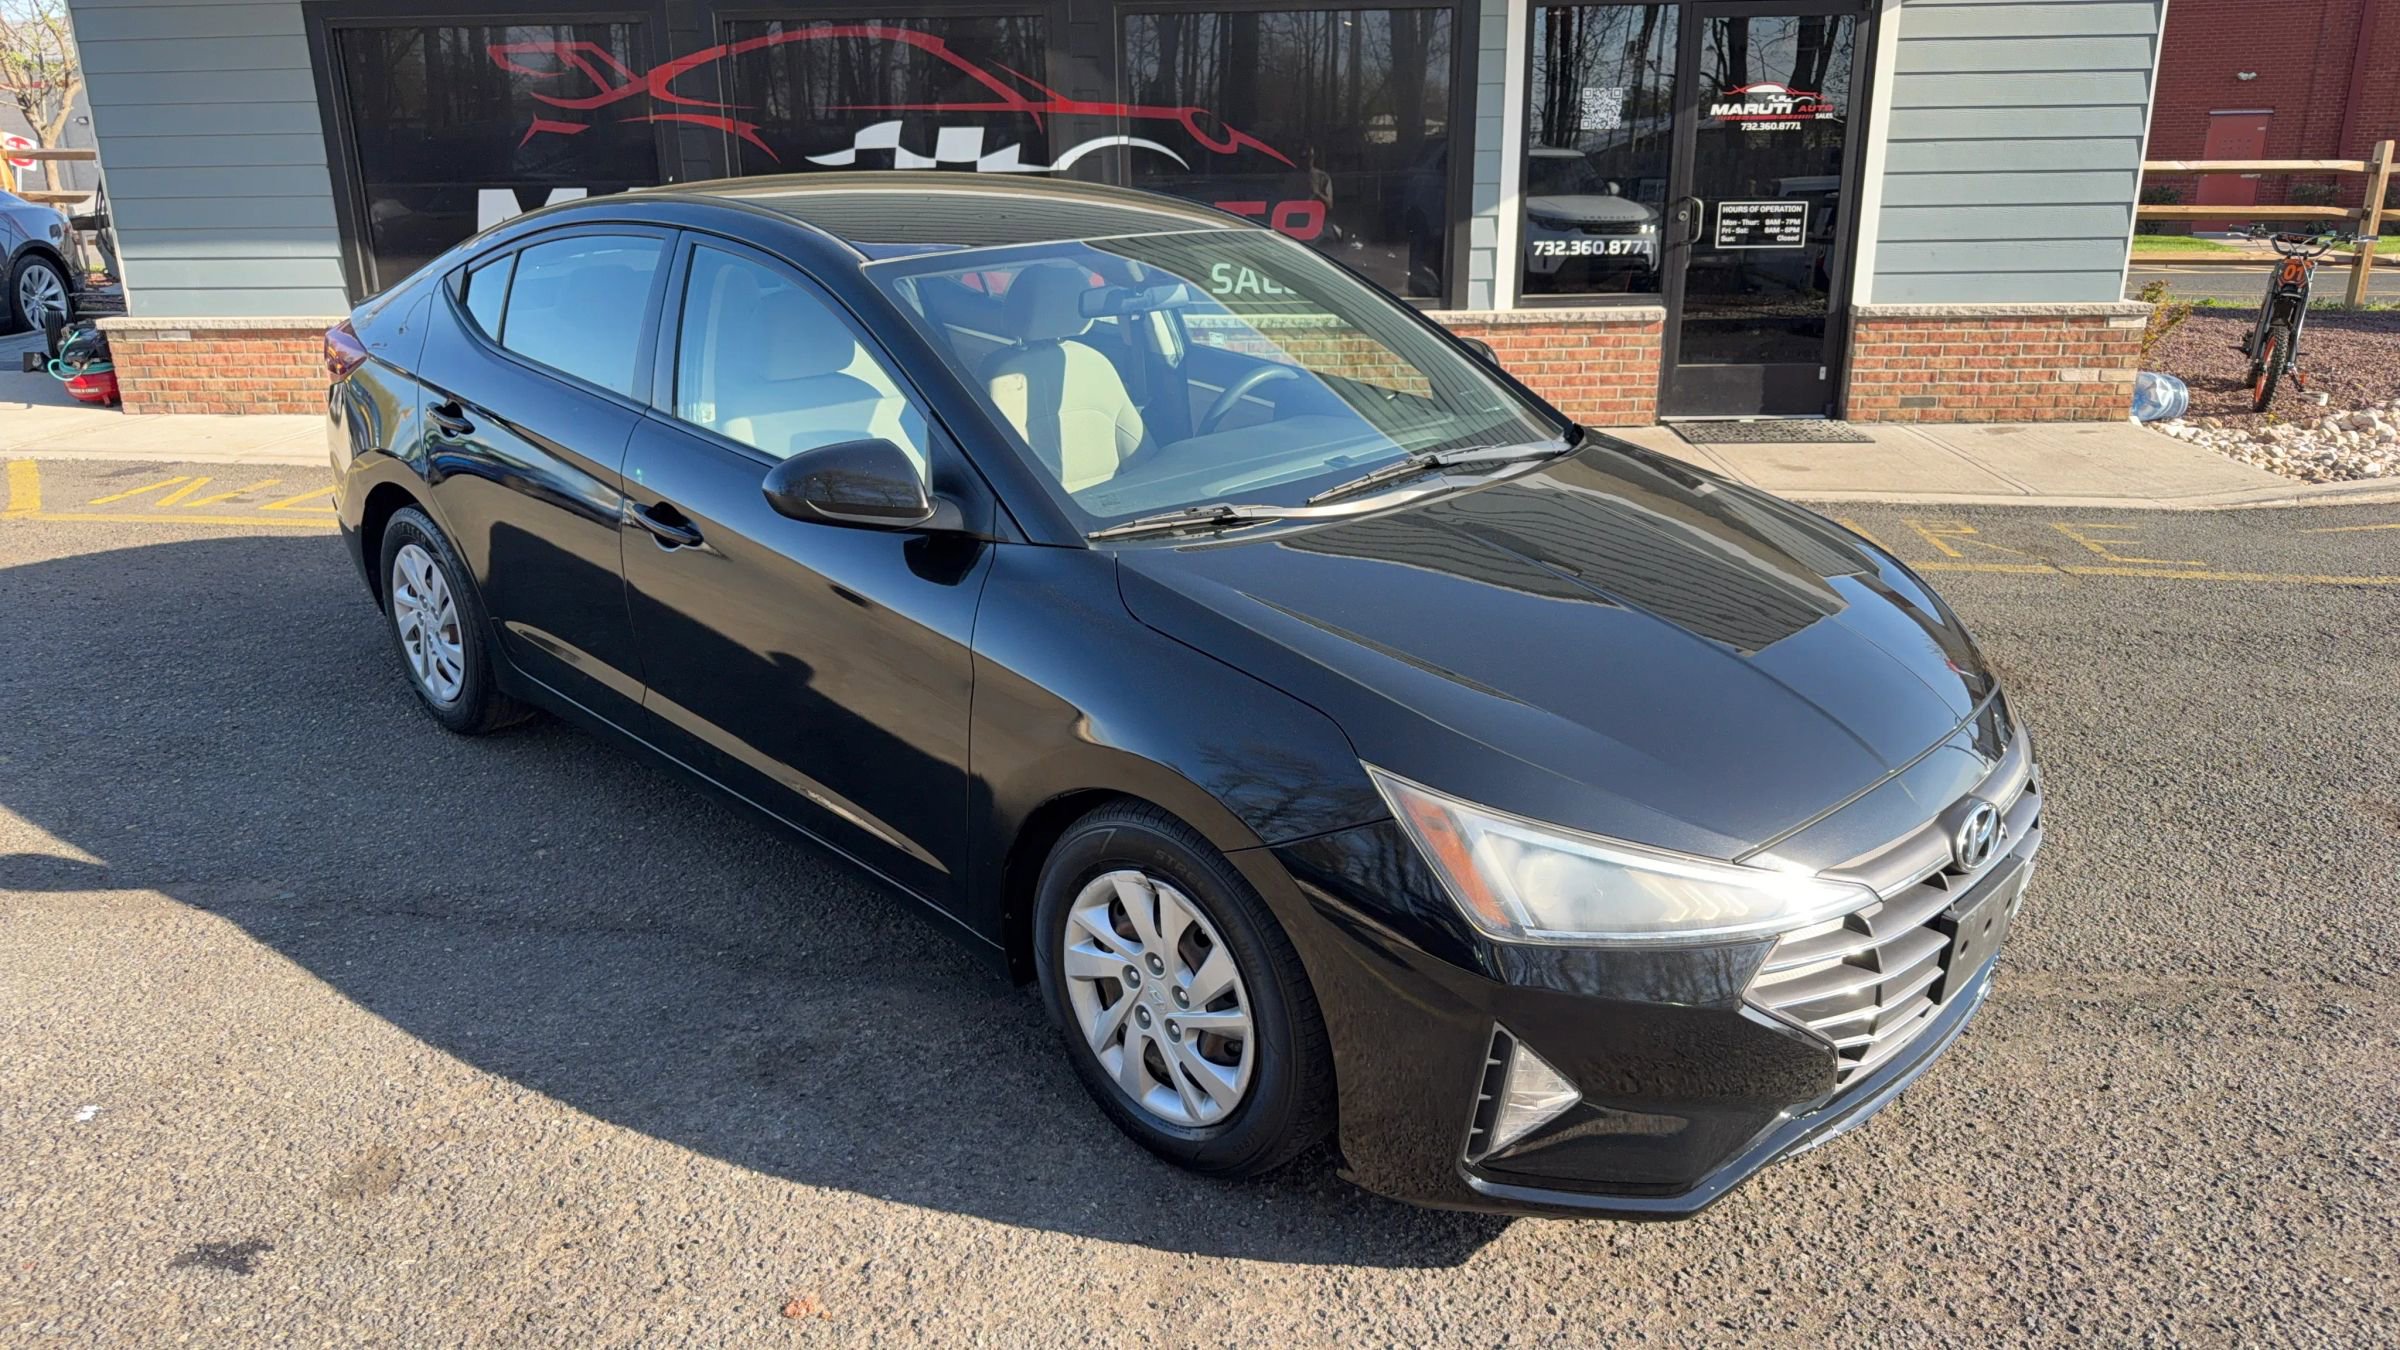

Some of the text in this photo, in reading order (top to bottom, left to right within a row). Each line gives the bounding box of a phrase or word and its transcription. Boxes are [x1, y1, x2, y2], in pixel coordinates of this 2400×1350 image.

[1710, 103, 1834, 115] MARUTI AUTO
[1740, 122, 1801, 131] 732.360.8771
[1722, 205, 1802, 213] HOURS OF OPERATION
[1776, 234, 1800, 242] Closed
[1533, 240, 1652, 256] 732.360.8771
[1211, 262, 1297, 294] SAL
